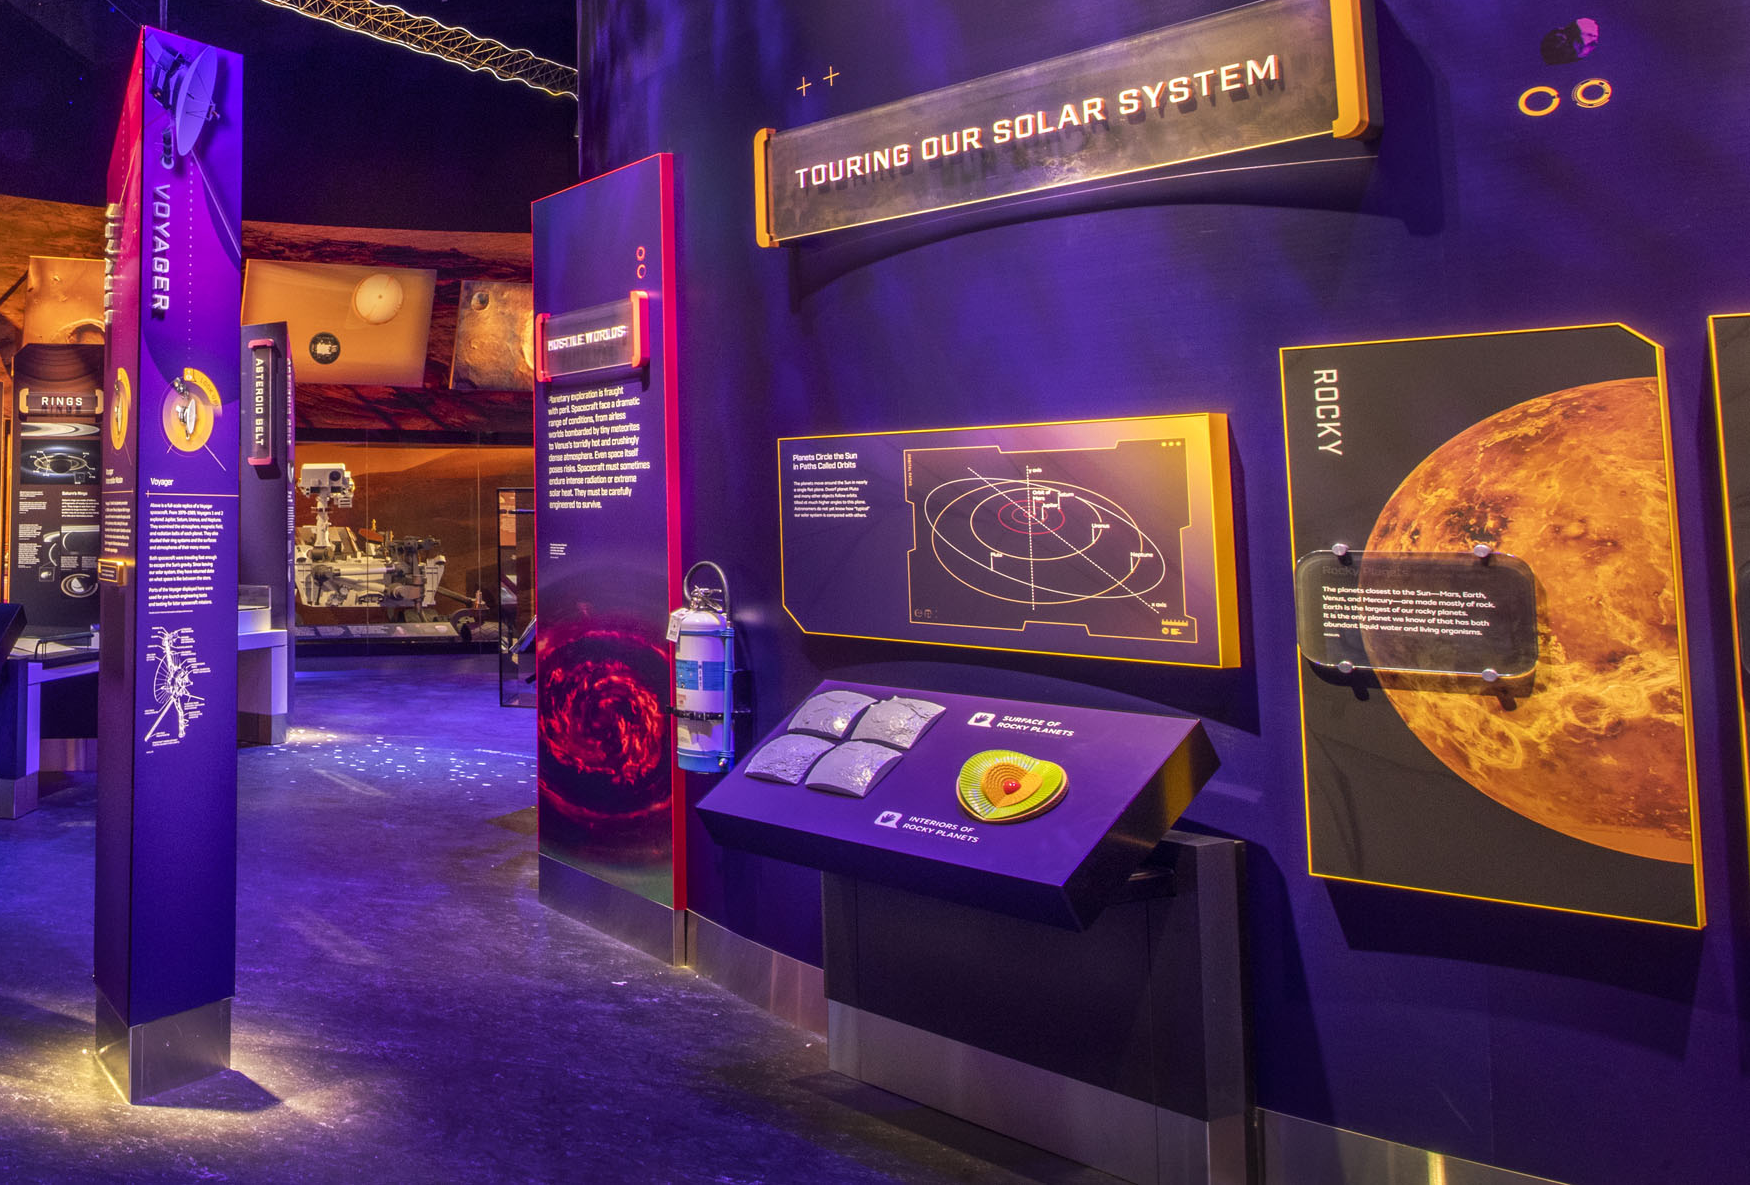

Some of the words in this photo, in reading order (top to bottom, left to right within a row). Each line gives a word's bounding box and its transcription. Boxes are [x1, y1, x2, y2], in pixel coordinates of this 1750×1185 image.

[795, 143, 910, 189] TOURING
[921, 127, 981, 161] OUR
[992, 96, 1104, 143] SOLAR
[1118, 55, 1279, 114] SYSTEM
[152, 184, 171, 310] VOYAGER
[548, 334, 585, 351] HOSTILE
[586, 325, 627, 344] WORLDS
[41, 397, 83, 406] RINGS
[1314, 369, 1343, 456] ROCKY
[255, 418, 264, 446] BELT
[150, 478, 174, 487] Voyager
[1338, 587, 1364, 596] planets
[1463, 591, 1487, 599] Earth,
[1323, 595, 1346, 603] Venus,
[1415, 598, 1437, 606] made
[1439, 599, 1465, 608] mostly
[1476, 600, 1496, 608] rock.
[1323, 603, 1343, 611] Earth
[1365, 605, 1391, 614] largest
[1415, 607, 1437, 616] rocky
[1438, 608, 1468, 618] planets.
[1351, 614, 1367, 622] only
[1368, 614, 1391, 623] planet
[1437, 617, 1454, 625] that
[1323, 621, 1358, 629] abundant
[1359, 623, 1379, 632] liquid
[1380, 624, 1402, 632] water
[1420, 626, 1439, 635] living
[1441, 627, 1483, 637] organisms.
[1003, 715, 1045, 726] SURFACE
[997, 722, 1030, 732] ROCKY
[1030, 726, 1075, 737] PLANETS
[909, 816, 959, 831] INTERIORS
[902, 823, 933, 835] ROCKY
[935, 829, 980, 843] PLANETS
